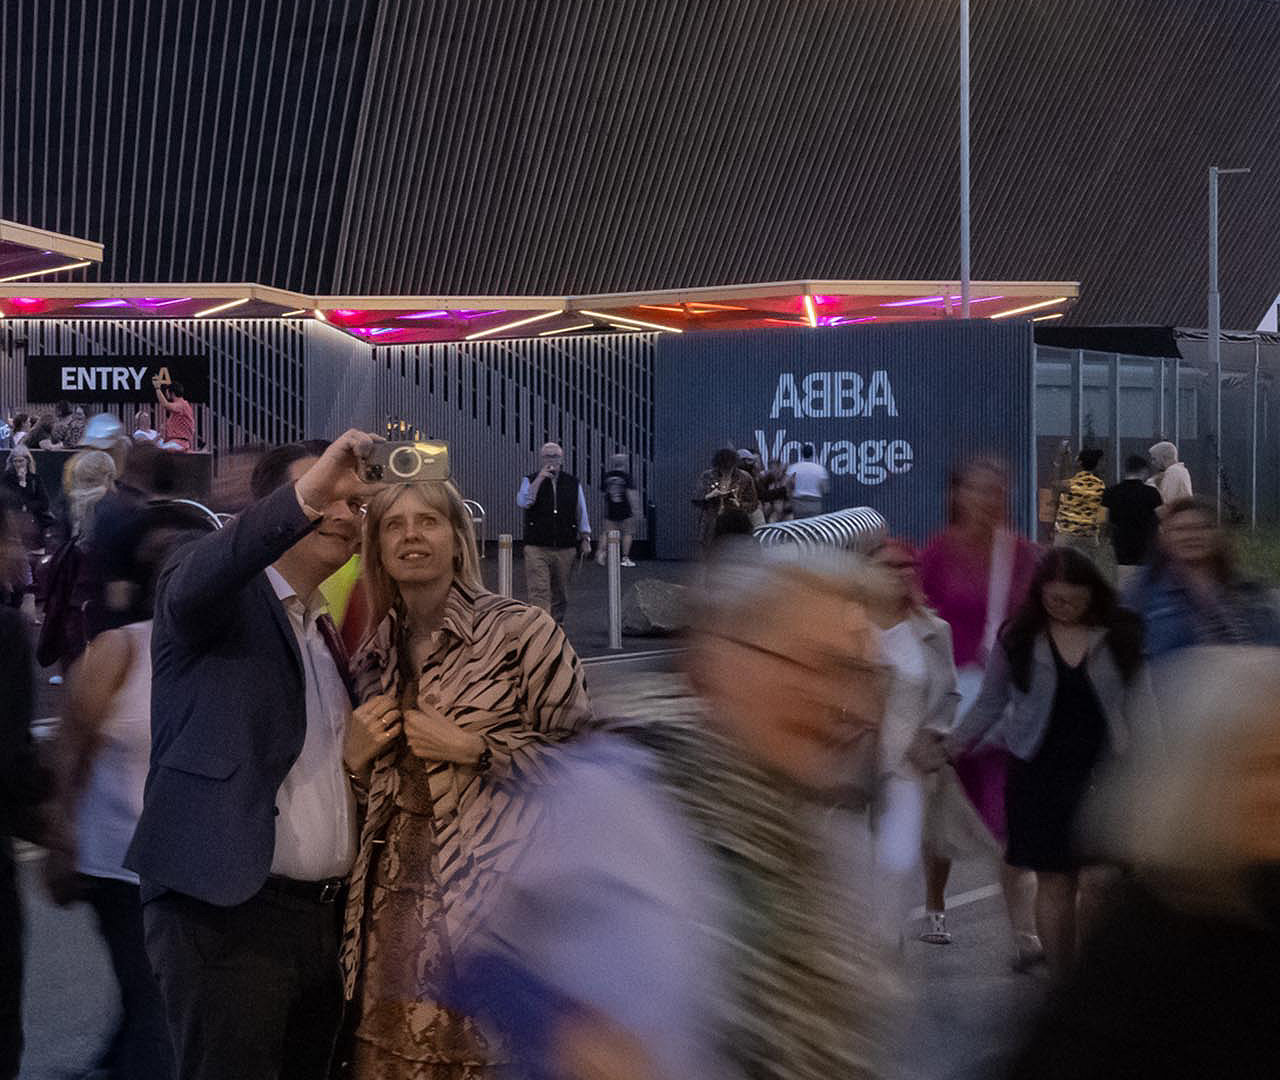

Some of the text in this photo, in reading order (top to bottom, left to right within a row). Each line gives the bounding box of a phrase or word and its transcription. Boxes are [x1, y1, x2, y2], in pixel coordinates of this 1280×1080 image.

[61, 366, 172, 391] ENTRY A
[769, 370, 899, 419] ABBA
